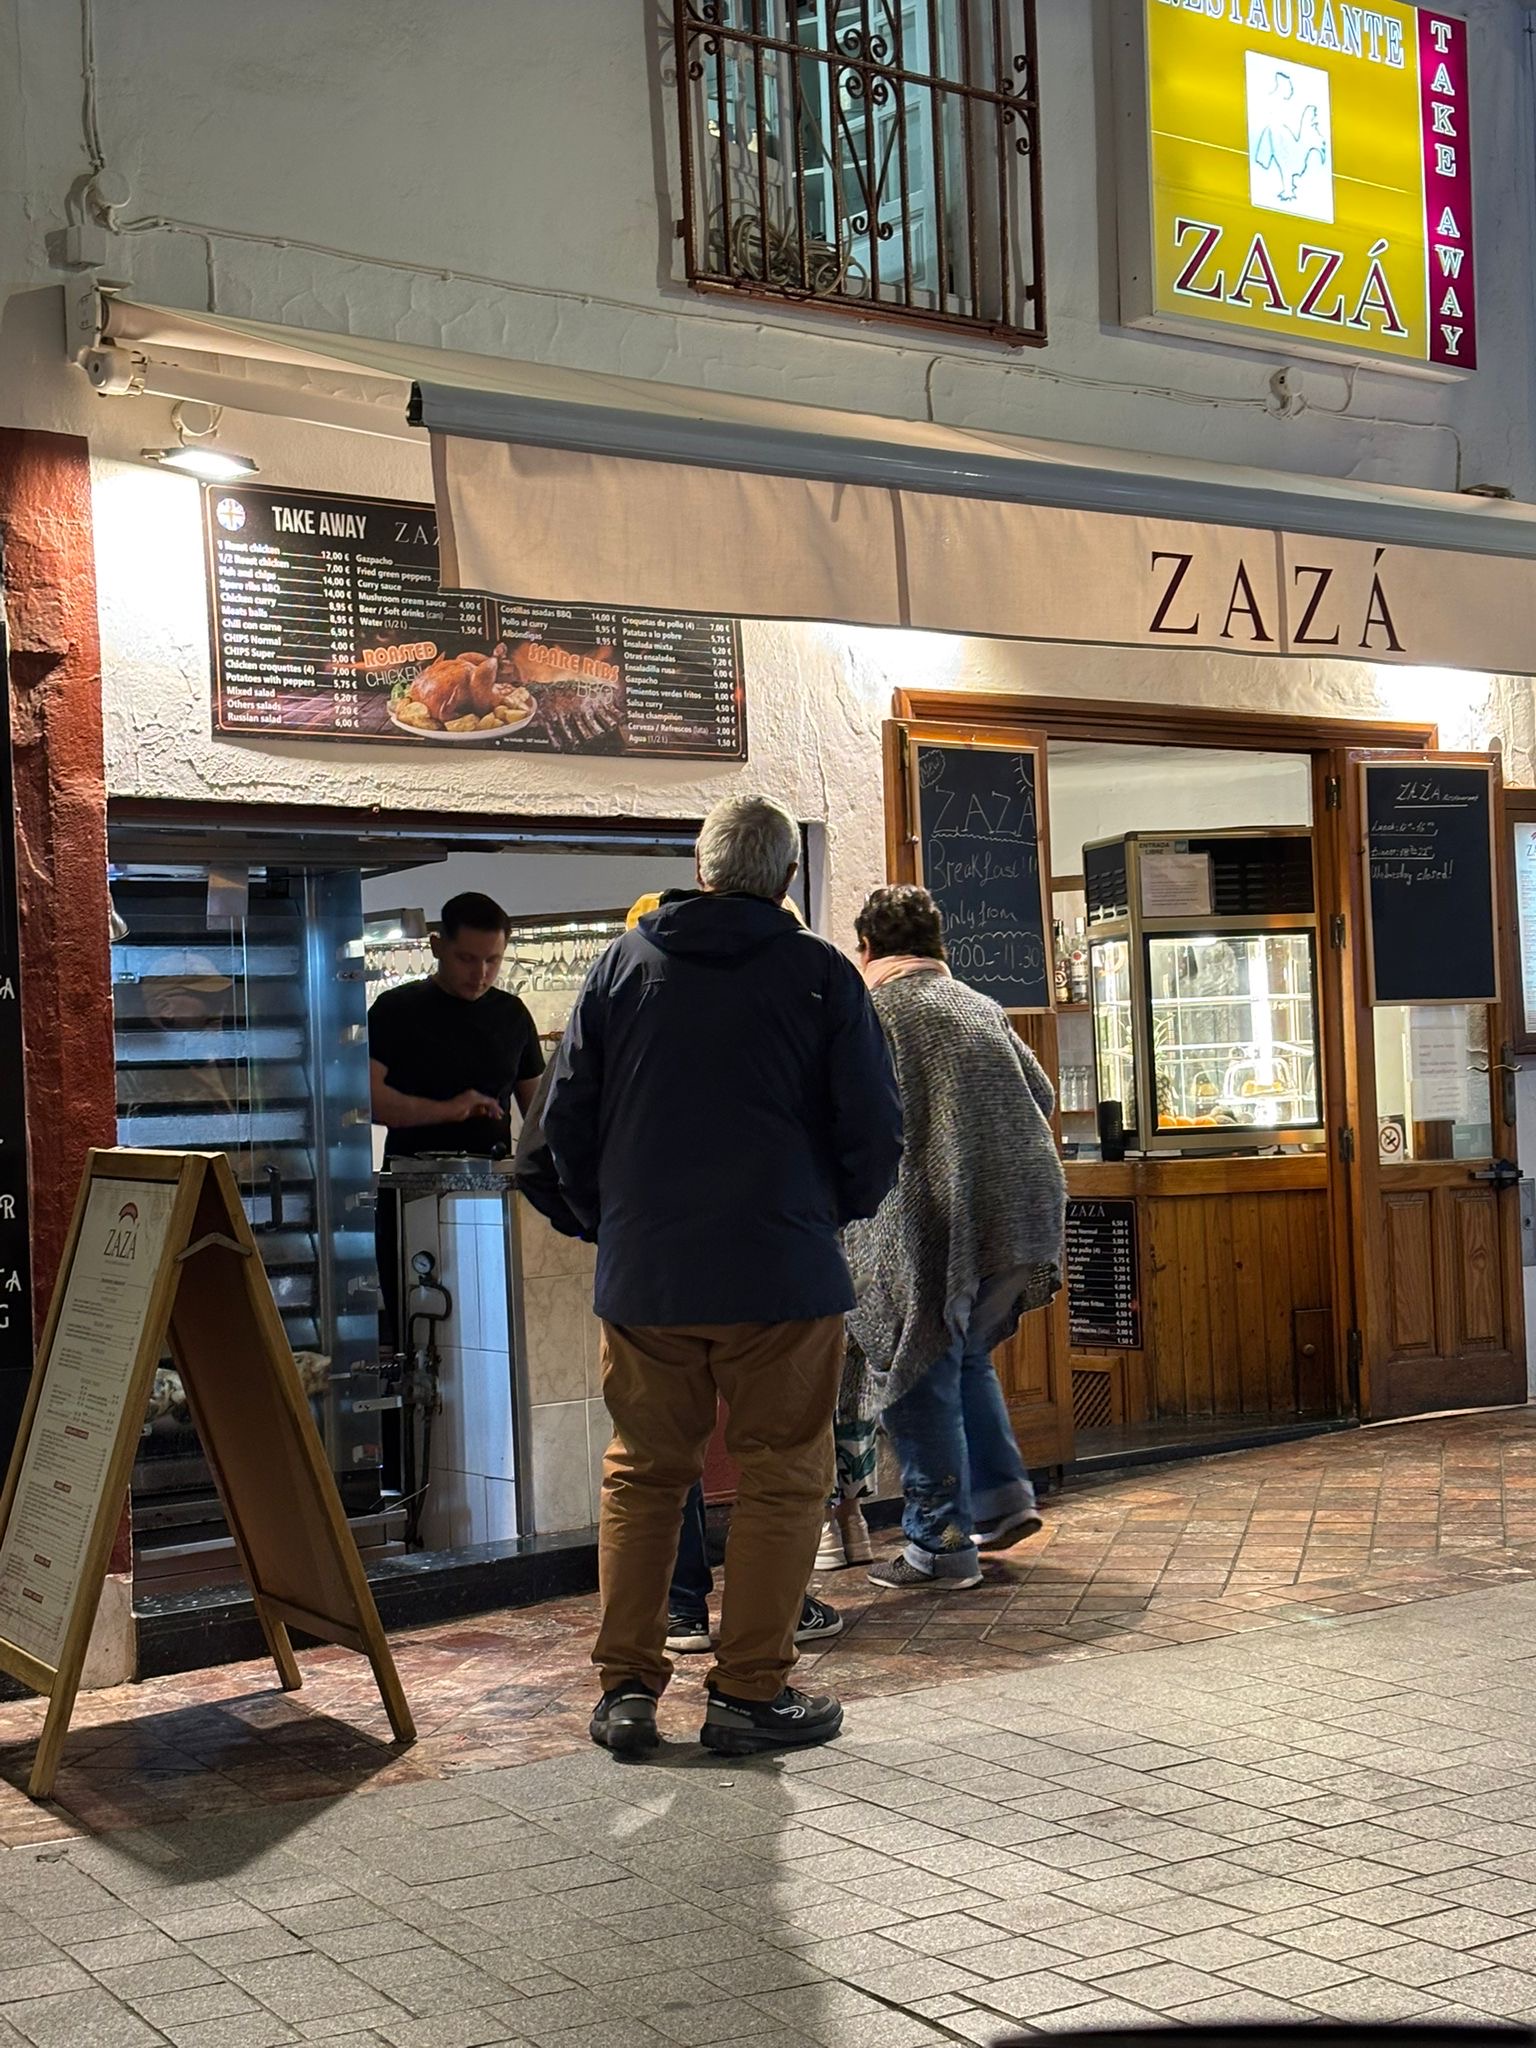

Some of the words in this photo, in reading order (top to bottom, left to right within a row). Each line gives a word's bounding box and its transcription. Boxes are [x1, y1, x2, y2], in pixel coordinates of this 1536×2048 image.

[1430, 20, 1456, 177] TAKE
[1173, 217, 1408, 338] ZAZÁ
[1435, 207, 1464, 355] AWAY
[271, 506, 317, 534] TAKE
[319, 511, 367, 539] AWAY
[321, 551, 343, 562] 12,00
[356, 554, 394, 566] Gazpacho
[258, 558, 290, 569] chicken
[326, 563, 343, 574] 7,00
[356, 566, 377, 578] Fried
[377, 570, 400, 580] green
[401, 573, 432, 584] peppers
[254, 569, 277, 582] chips
[323, 576, 345, 588] 14,00
[357, 579, 380, 591] Curry
[380, 582, 402, 592] sauce
[262, 583, 281, 595] BBQ
[324, 589, 345, 600] 14,00
[358, 591, 400, 604] Mushroom
[401, 597, 424, 606] cream
[425, 598, 447, 608] sauce
[458, 601, 475, 610] 4,00
[1149, 548, 1406, 652] ZAZÁ
[254, 596, 277, 608] curry
[328, 602, 346, 613] 8,95
[358, 604, 377, 614] Beer
[383, 606, 400, 617] Soft
[401, 609, 425, 619] drinks
[425, 610, 444, 622] (can)
[459, 613, 476, 623] 2,00
[500, 605, 530, 616] Costillas
[531, 609, 555, 618] asadas
[556, 611, 572, 620] BBQ
[591, 613, 610, 622] 14,00
[242, 621, 258, 630] con
[259, 623, 282, 633] carne
[330, 628, 348, 638] 6,50
[329, 615, 347, 626] 8,95
[359, 616, 383, 628] Water
[461, 626, 476, 636] 1,50
[501, 617, 520, 626] Pollo
[529, 622, 548, 630] curry
[595, 625, 610, 634] 8,95
[622, 616, 656, 627] Croquetas
[666, 621, 685, 631] pollo
[686, 622, 696, 632] (4)
[709, 623, 725, 632] 7,00
[223, 632, 250, 644] CHIPS
[250, 634, 282, 647] Normal
[330, 641, 348, 652] 4,00
[502, 629, 543, 641] Albóndigas
[622, 628, 648, 638] Patatas
[653, 631, 661, 639] lo
[661, 632, 682, 642] pobre
[711, 635, 726, 644] 5,75
[224, 645, 250, 657] CHIPS
[251, 648, 276, 660] Super
[331, 654, 349, 664] 5,00
[363, 641, 437, 668] ROASTED
[623, 640, 654, 650] Ensalada
[654, 642, 674, 651] mixta
[712, 647, 727, 656] 6,20
[225, 659, 258, 670] Chicken
[259, 661, 302, 674] croquettes
[303, 664, 315, 676] (4)
[332, 667, 349, 677] 7,00
[528, 643, 580, 673] SPARE
[582, 657, 620, 683] RIBS
[624, 652, 644, 662] Otras
[644, 654, 676, 664] ensaladas
[712, 658, 728, 668] 7,20
[226, 672, 262, 684] Potatoes
[263, 675, 282, 685] with
[283, 677, 316, 689] peppers
[333, 680, 350, 690] 5,75
[366, 664, 423, 687] CHICKEN
[624, 664, 660, 674] Ensaladilla
[661, 667, 676, 675] rusa
[713, 670, 728, 680] 6,00
[625, 675, 659, 686] Gazpacho
[714, 681, 729, 690] 5,00
[226, 685, 252, 697] Mixed
[254, 687, 276, 698] salad
[334, 693, 351, 703] 6,20
[577, 680, 615, 706] BBQ
[626, 687, 660, 698] Pimientos
[661, 690, 683, 700] verdes
[684, 690, 702, 700] fritos
[714, 693, 729, 702] 8,00
[227, 698, 255, 711] Others
[256, 701, 283, 711] salads
[335, 706, 352, 716] 7,20
[627, 699, 645, 708] Salsa
[645, 701, 663, 711] curry
[715, 704, 730, 713] 4,50
[227, 711, 259, 723] Russian
[260, 714, 282, 724] salad
[336, 719, 353, 729] 6,00
[627, 711, 645, 720] Salsa
[715, 716, 731, 725] 4,00
[628, 722, 655, 733] Cerveza
[660, 724, 692, 734] Refrescos
[716, 727, 731, 737] 2,00
[630, 734, 647, 744] Agua
[717, 738, 732, 748] 1,50
[977, 900, 1020, 928] from
[103, 1223, 140, 1260] ZAZÁ
